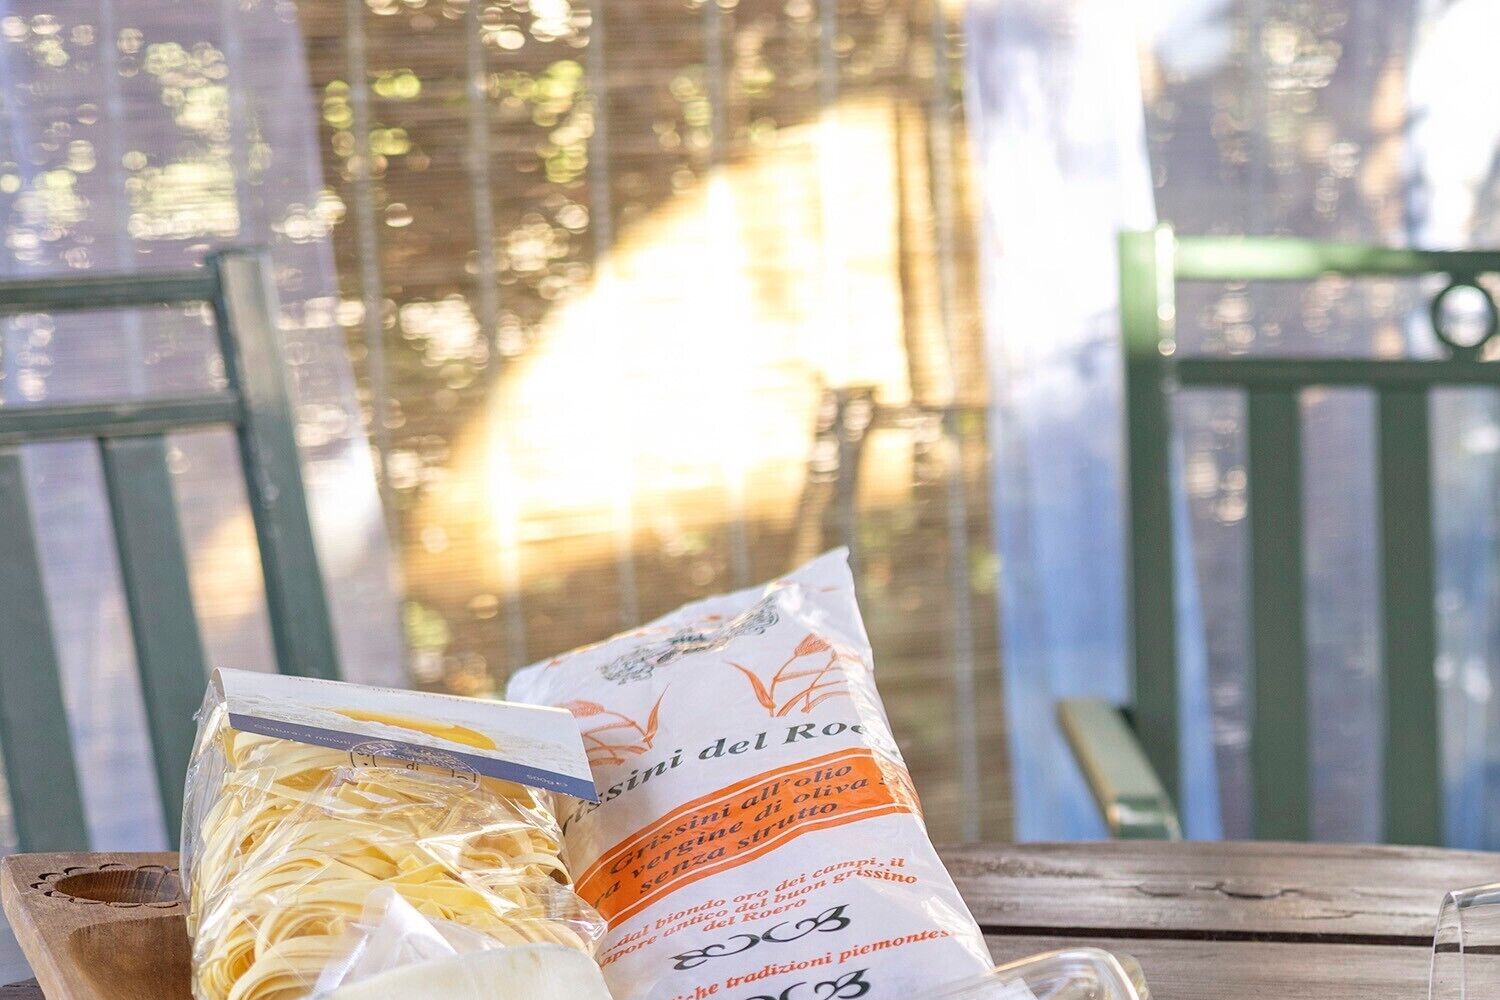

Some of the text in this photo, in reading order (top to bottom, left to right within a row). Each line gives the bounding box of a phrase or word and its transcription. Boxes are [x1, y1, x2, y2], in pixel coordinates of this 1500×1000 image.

[697, 731, 768, 762] del
[609, 803, 731, 875] Grissini
[631, 821, 742, 880] vergine
[753, 800, 782, 823] di
[792, 779, 877, 805] oliva
[640, 802, 839, 894] senza strutto
[600, 868, 919, 968] apore antico del buon grissino
[655, 898, 726, 931] biondo
[732, 887, 769, 905] oro
[776, 872, 807, 891] dei
[811, 857, 886, 881] campi,
[889, 857, 905, 869] il
[702, 899, 808, 933] del Roero
[725, 951, 832, 990] tradizioni
